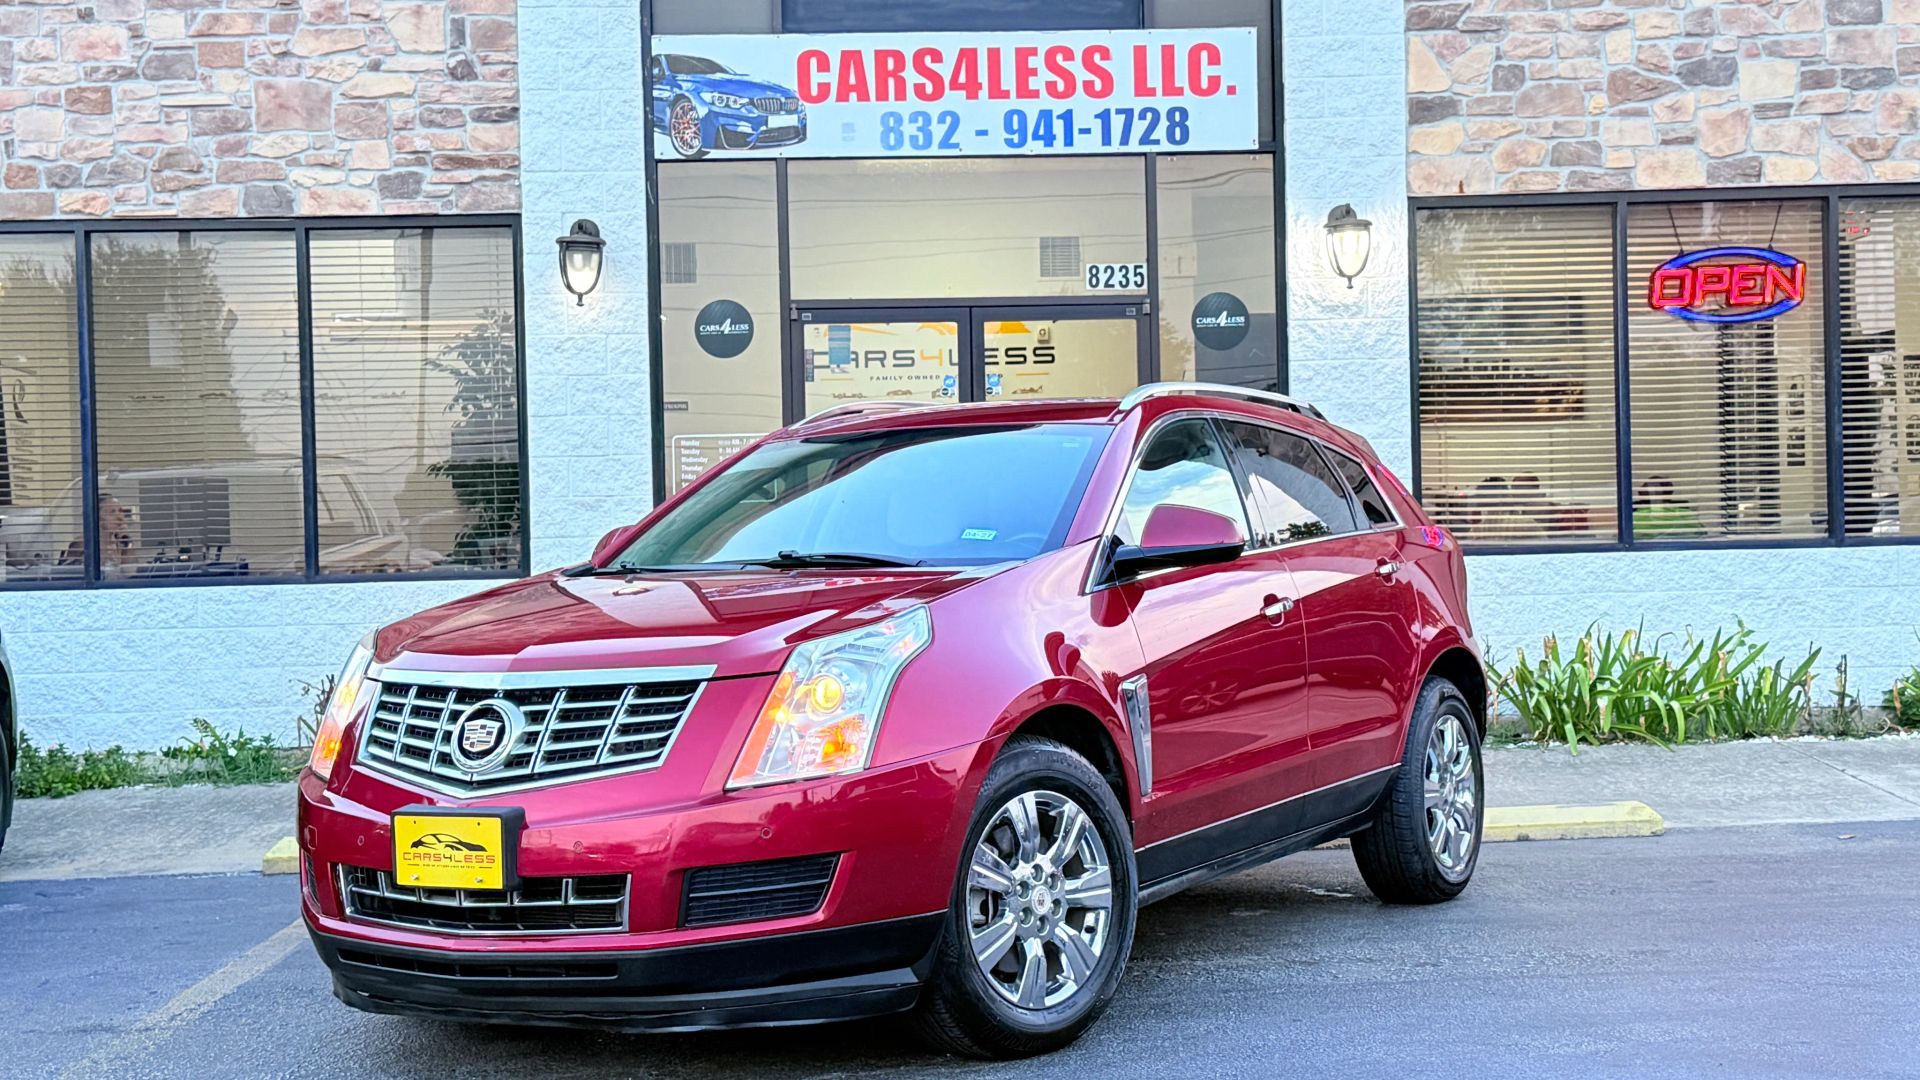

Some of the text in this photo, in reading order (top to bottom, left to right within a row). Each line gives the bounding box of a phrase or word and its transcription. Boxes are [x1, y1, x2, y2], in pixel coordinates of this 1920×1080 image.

[797, 42, 1237, 104] CARS4LESS LLC.
[880, 110, 960, 151] 832
[1003, 106, 1190, 148] 941-1728
[1088, 264, 1145, 289] 8235
[1651, 263, 1805, 308] OPEN
[403, 852, 495, 863] CARS4LESS
